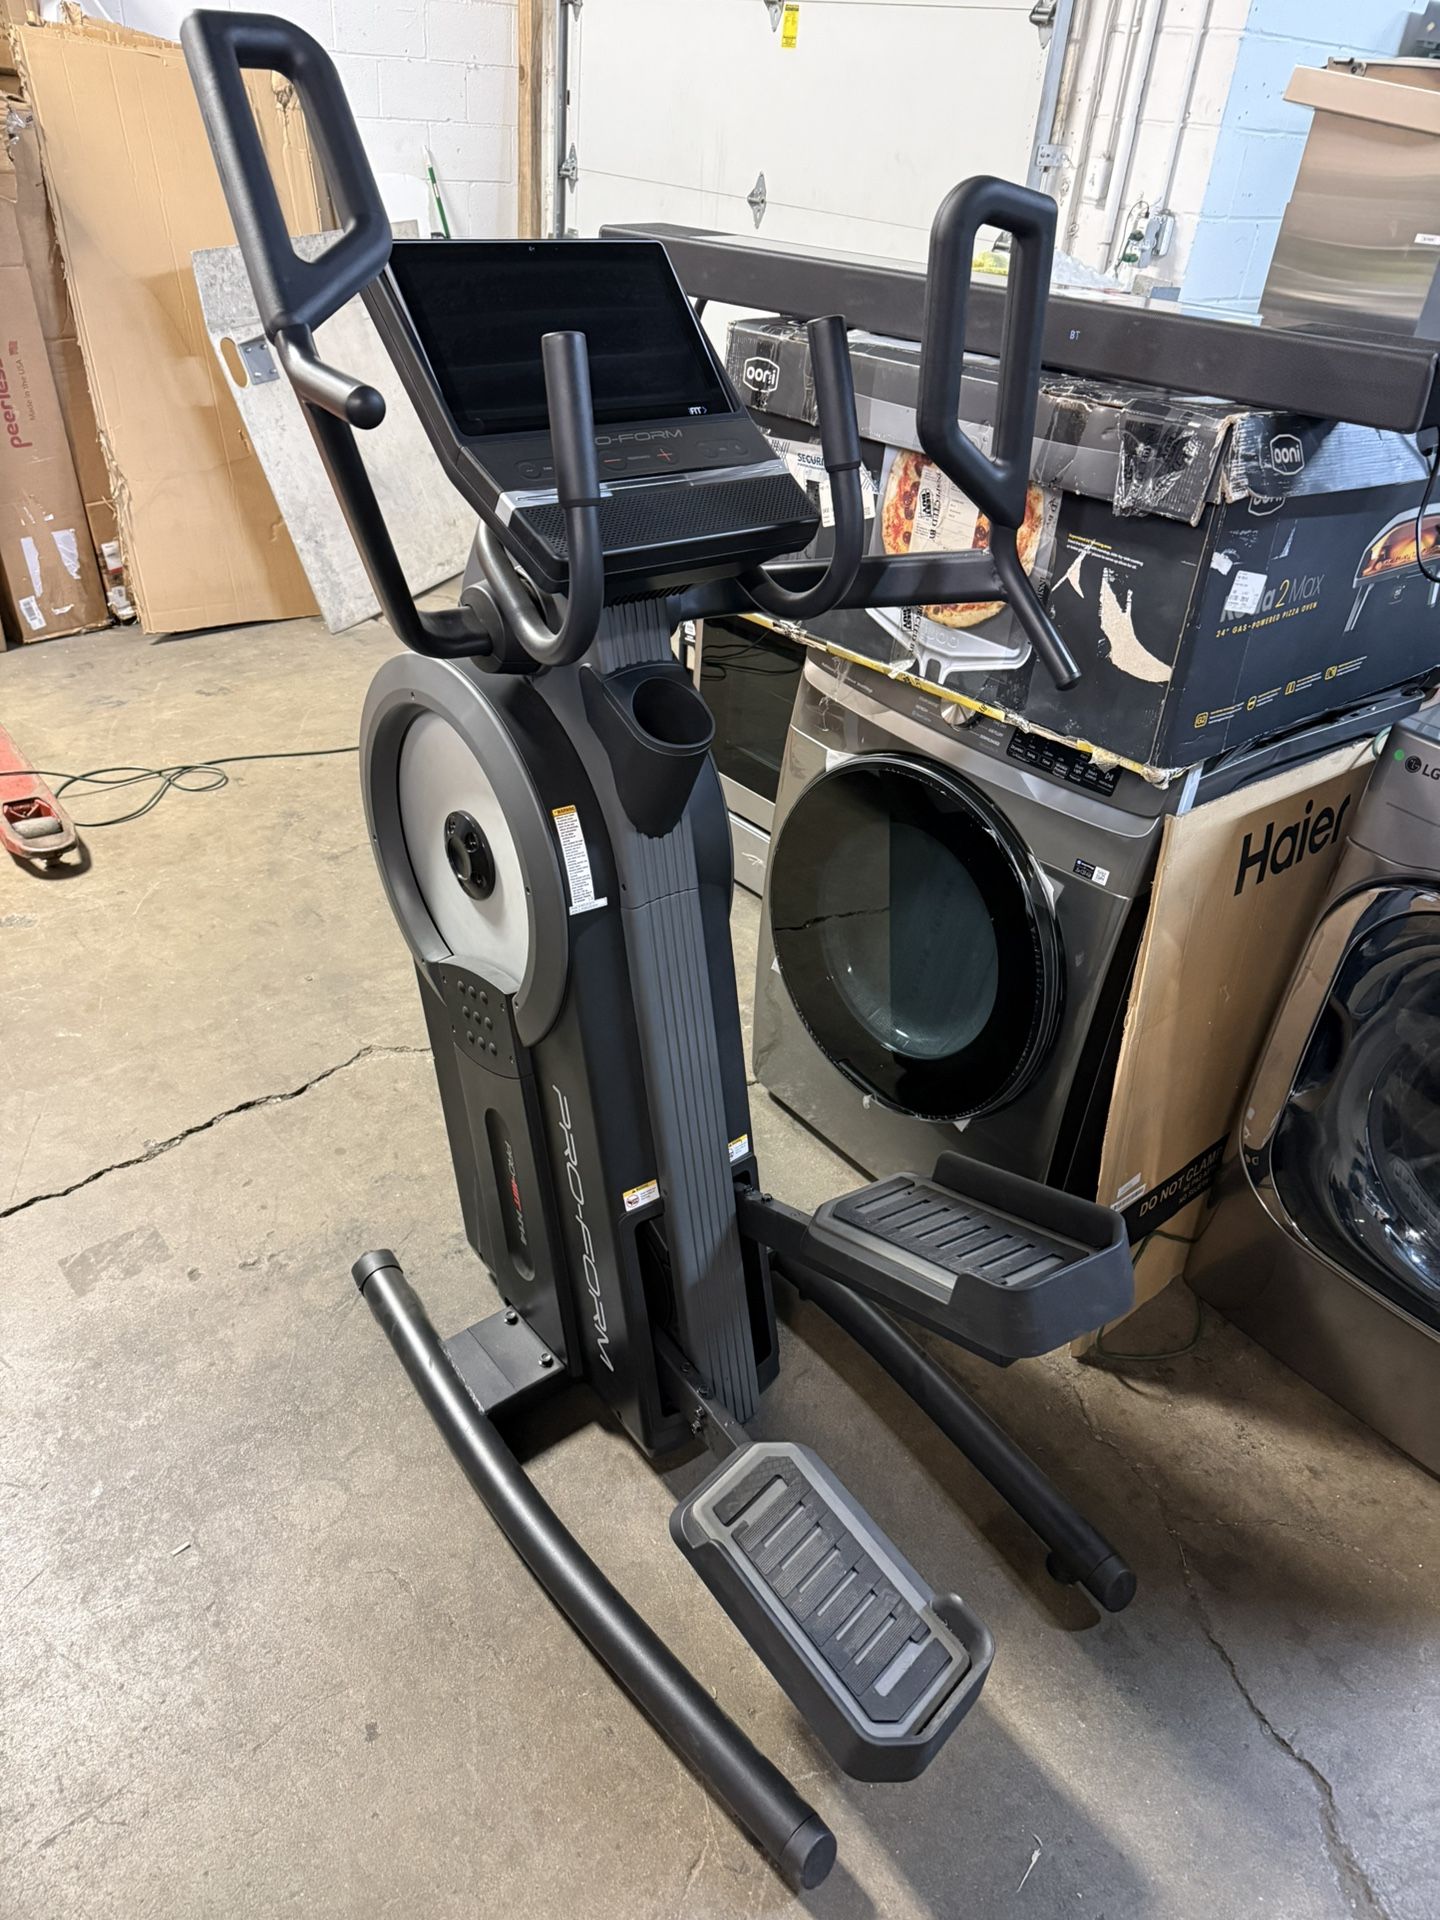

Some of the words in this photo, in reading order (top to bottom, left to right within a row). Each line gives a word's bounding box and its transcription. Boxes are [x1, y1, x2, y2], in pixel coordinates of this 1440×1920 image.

[1069, 329, 1081, 340] BT
[746, 366, 777, 385] ooni
[0, 358, 33, 449] peerles
[595, 429, 683, 446] O-FORM
[1274, 444, 1301, 464] ooni
[1274, 579, 1290, 608] 2
[1288, 574, 1325, 603] Max
[1282, 608, 1300, 619] PIZZA
[1301, 602, 1318, 613] OVEN
[1422, 764, 1440, 780] LG
[1234, 793, 1352, 897] Haier
[1140, 1195, 1158, 1217] DO
[1160, 1176, 1184, 1203] NOT
[552, 1084, 615, 1373] PRO-FORM
